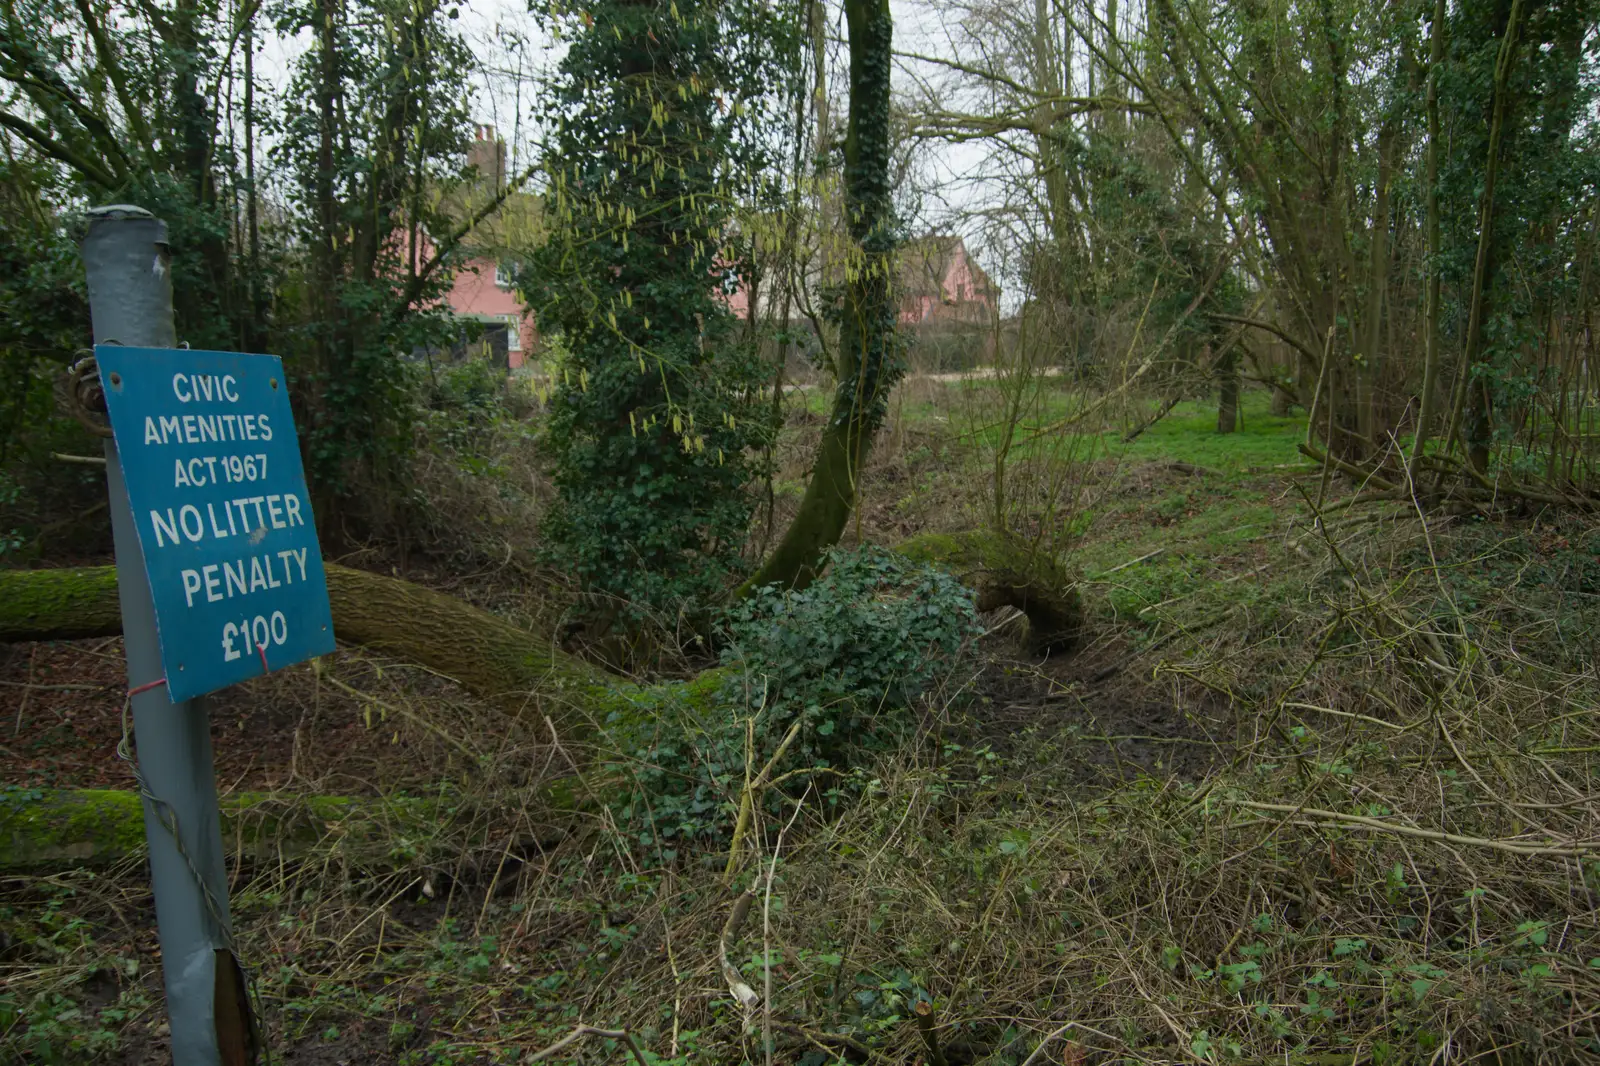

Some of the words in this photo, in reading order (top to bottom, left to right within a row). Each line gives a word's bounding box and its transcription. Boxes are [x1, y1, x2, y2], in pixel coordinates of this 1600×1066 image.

[173, 373, 239, 403] CIVIC
[145, 414, 273, 445] AMENITIES
[175, 457, 217, 488] ACT
[221, 454, 267, 483] 1967
[150, 505, 204, 547] NO
[207, 494, 304, 539] LITTER
[181, 548, 307, 607] PENALTY
[222, 611, 287, 662] £100
